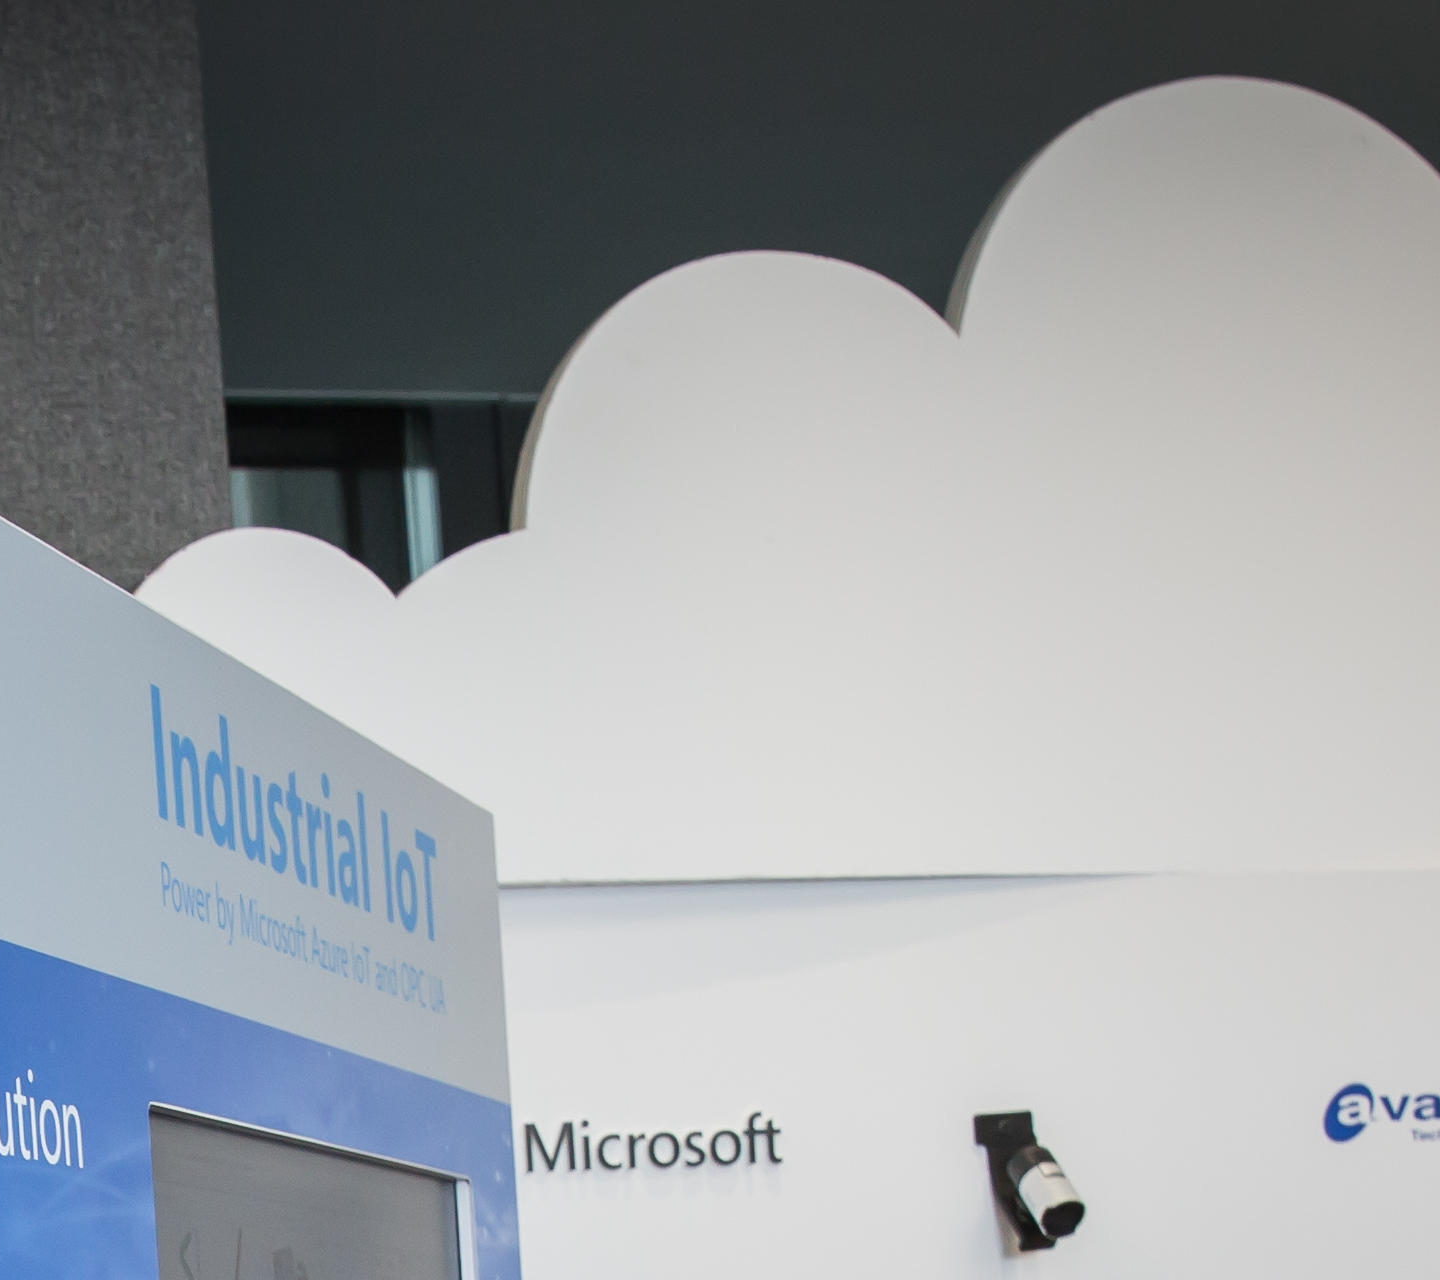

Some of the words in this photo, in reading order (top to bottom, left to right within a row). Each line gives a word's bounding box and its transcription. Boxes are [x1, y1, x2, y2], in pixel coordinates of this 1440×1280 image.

[150, 683, 370, 914] Industrial
[381, 810, 436, 941] IoT
[161, 861, 211, 924] Power
[215, 881, 235, 946] by
[239, 893, 309, 963] Microsoft
[311, 926, 348, 978] Azure
[352, 941, 370, 985] IoT
[524, 1112, 783, 1172] Microsoft
